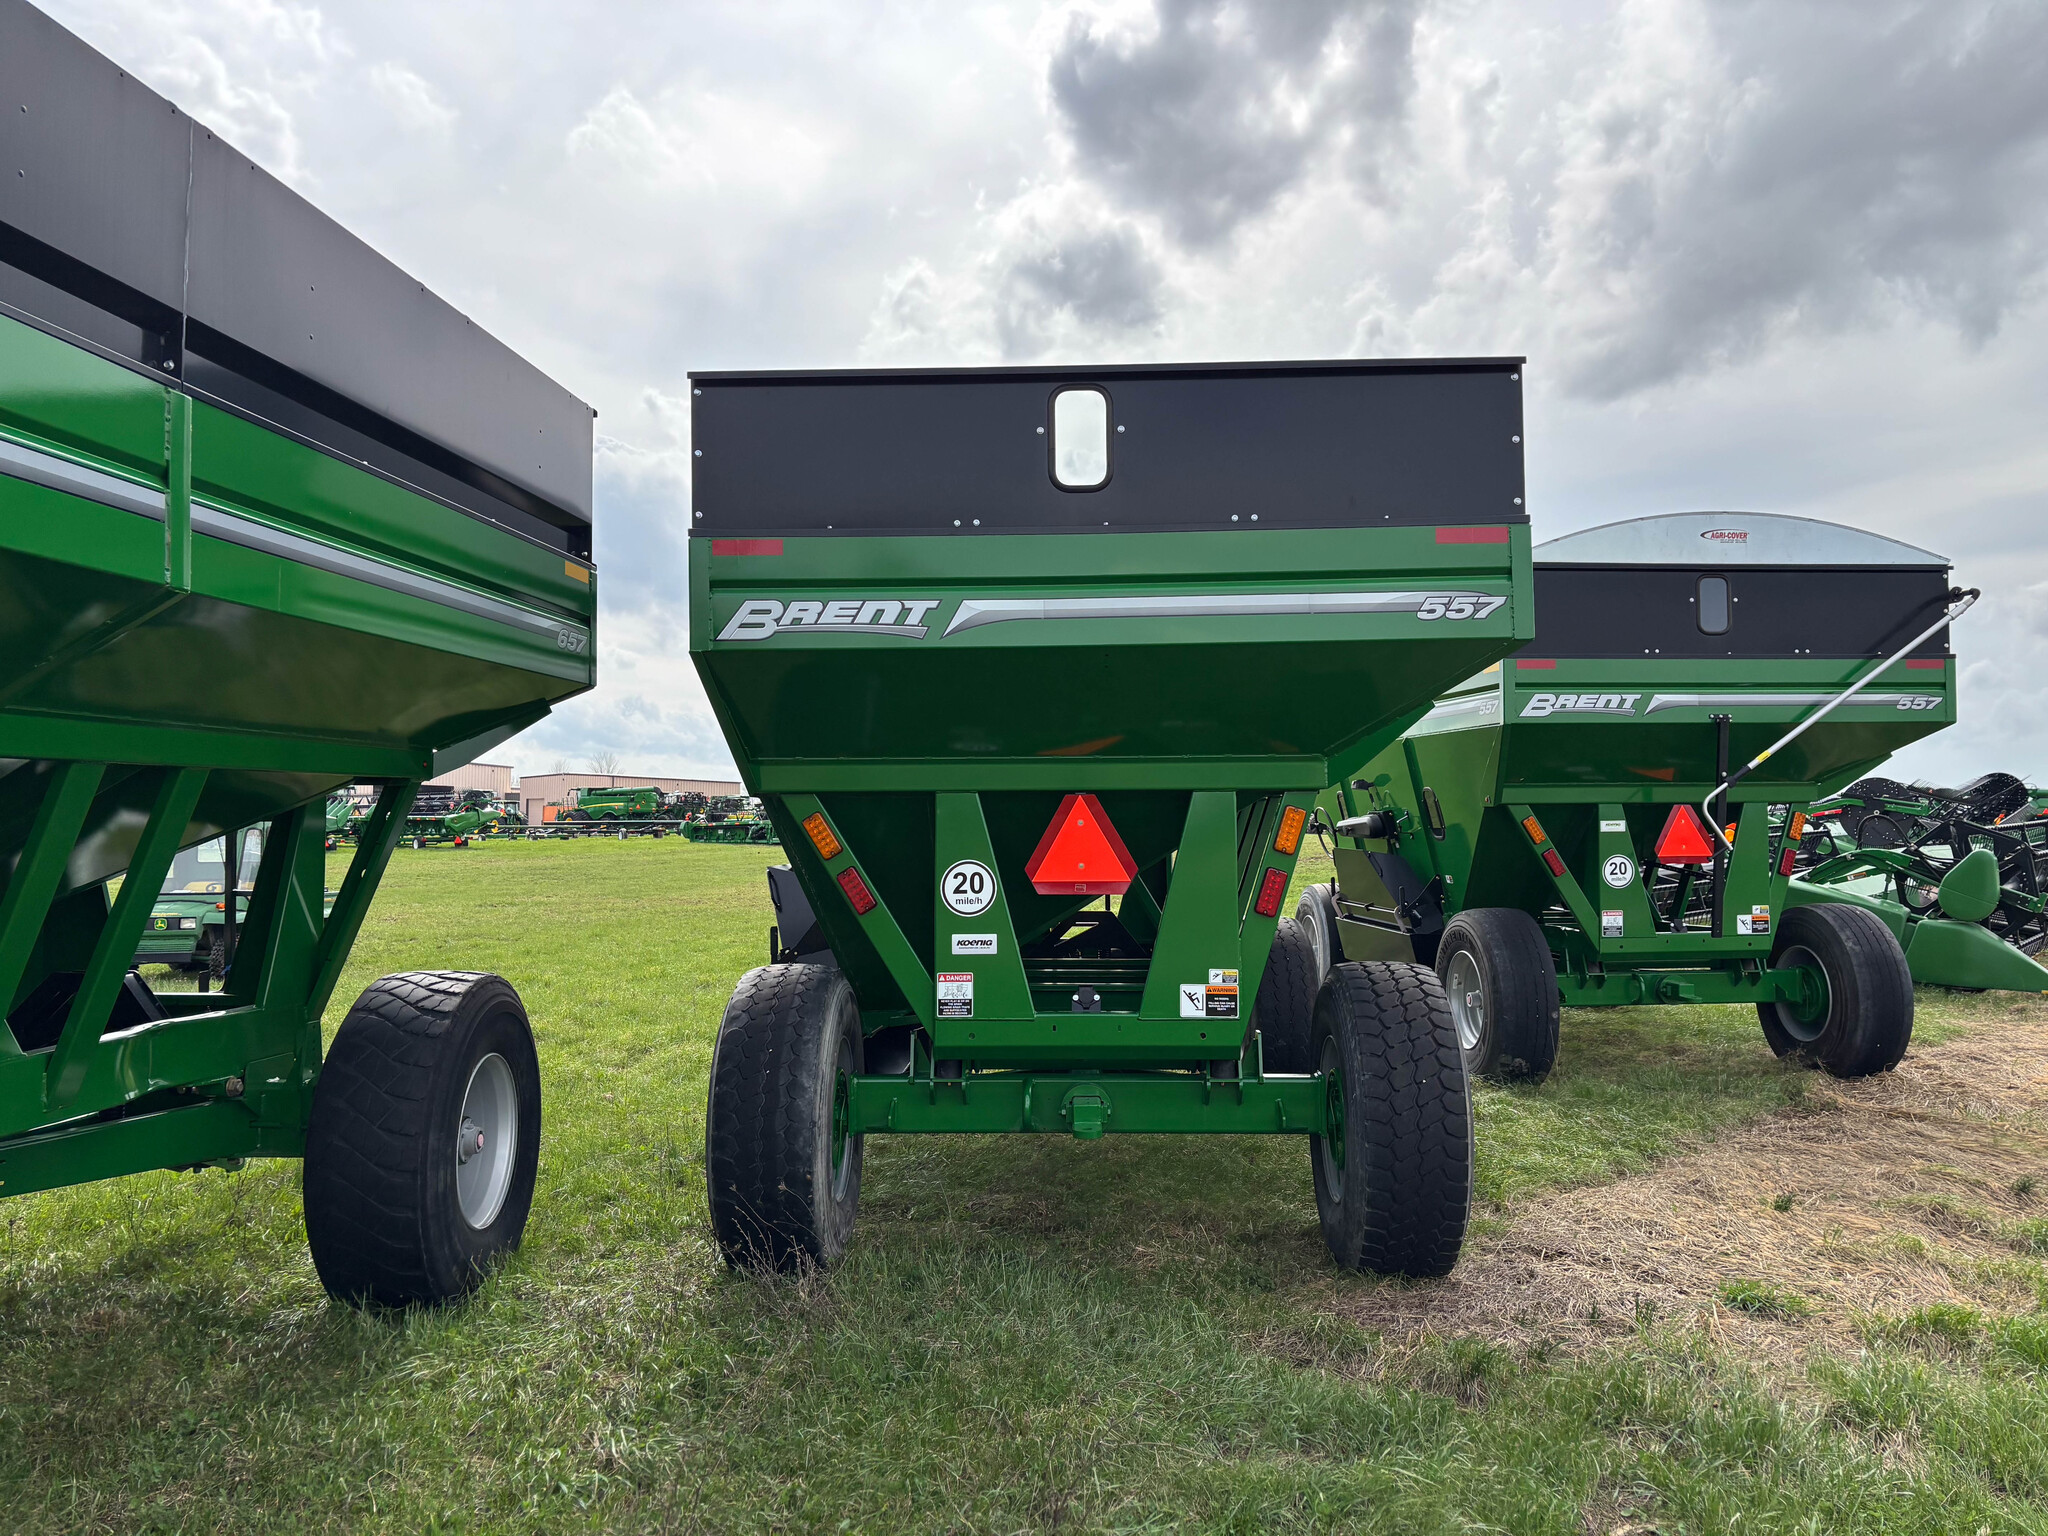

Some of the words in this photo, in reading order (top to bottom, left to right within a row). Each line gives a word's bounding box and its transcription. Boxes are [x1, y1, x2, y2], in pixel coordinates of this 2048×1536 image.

[1711, 531, 1748, 539] AGRI-COVER
[1416, 596, 1508, 621] 557
[717, 598, 941, 640] BRENT
[557, 629, 588, 653] 657
[1478, 697, 1500, 716] 557
[1519, 694, 1642, 717] BRENT
[1896, 696, 1944, 711] 557
[1609, 862, 1627, 876] 20
[952, 872, 985, 894] 20
[955, 896, 983, 905] mile/h
